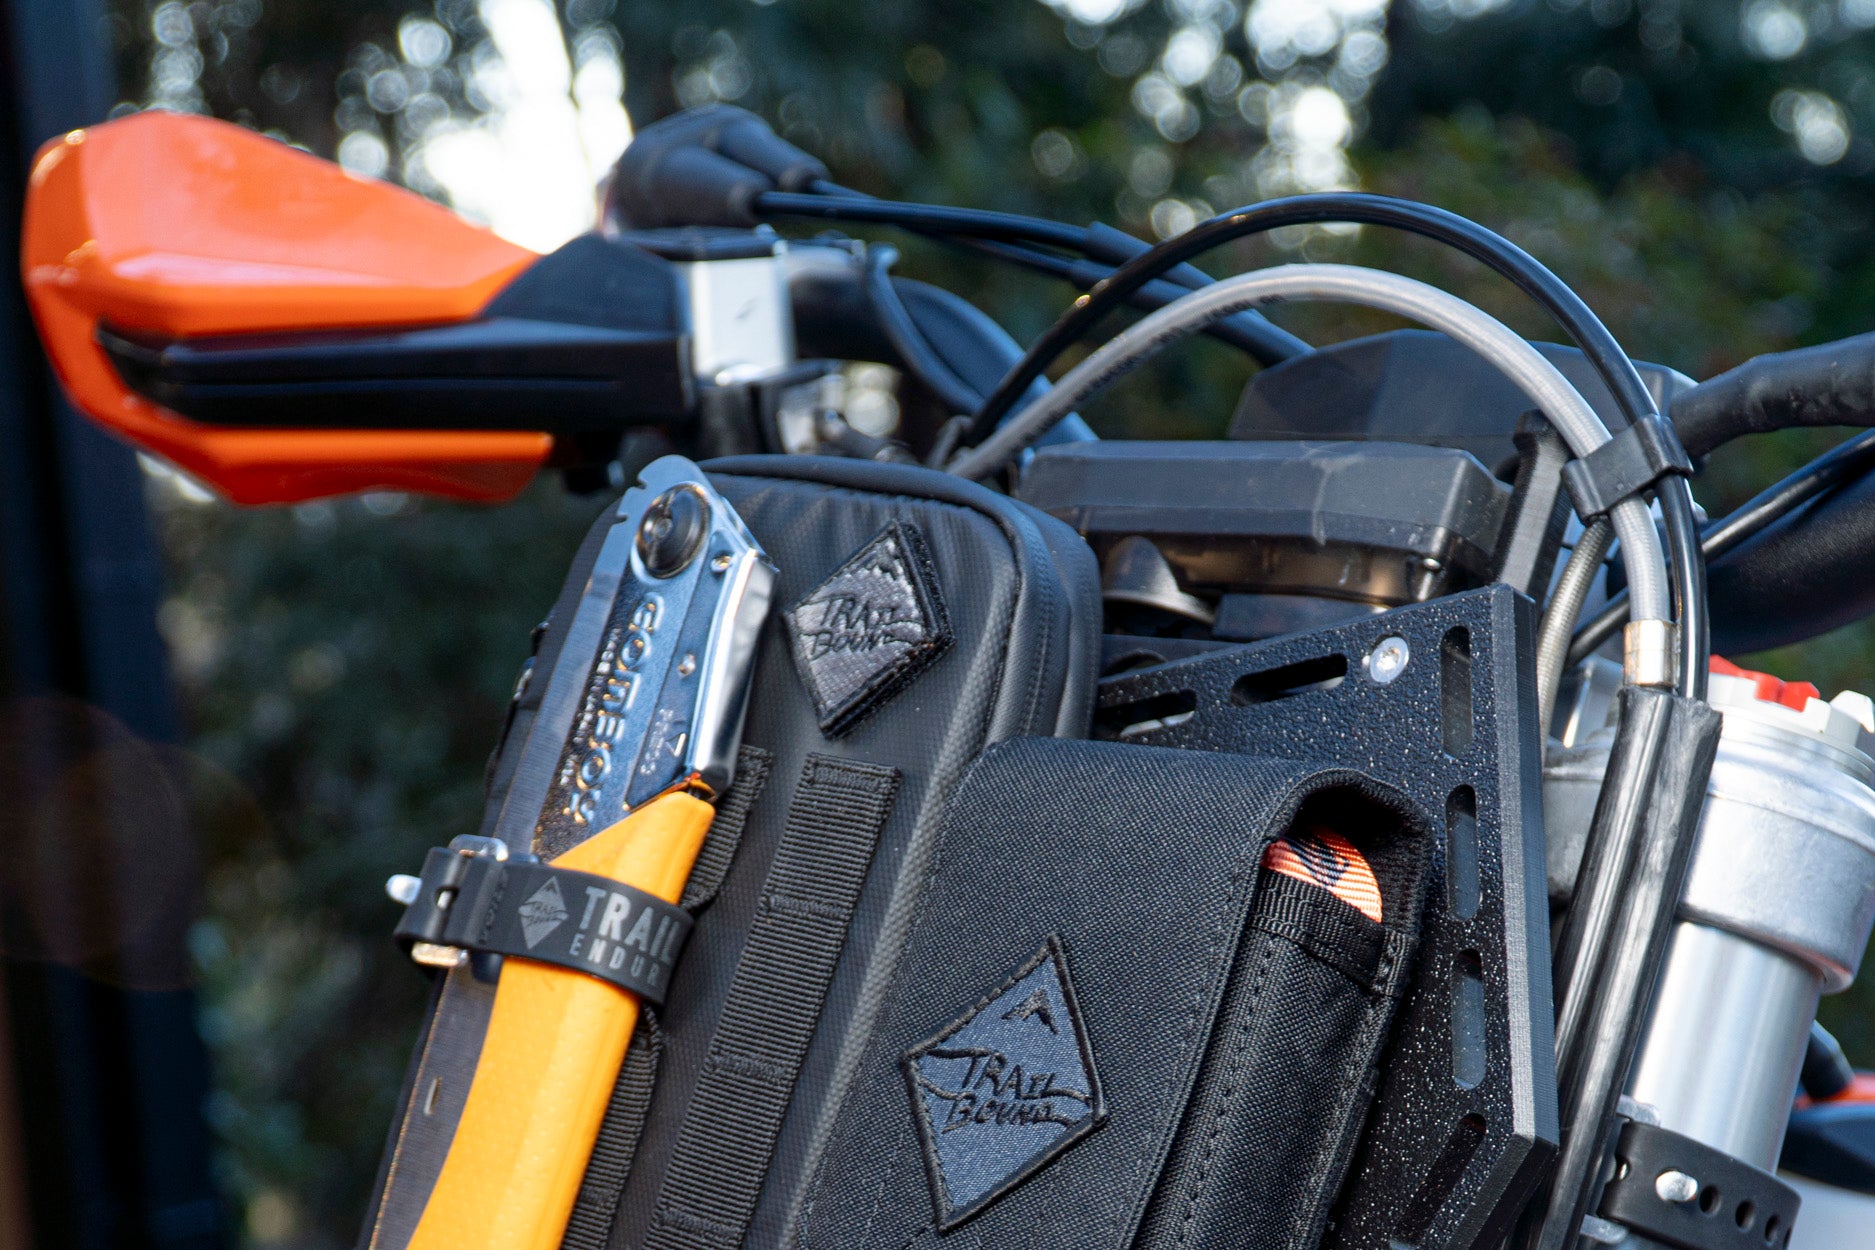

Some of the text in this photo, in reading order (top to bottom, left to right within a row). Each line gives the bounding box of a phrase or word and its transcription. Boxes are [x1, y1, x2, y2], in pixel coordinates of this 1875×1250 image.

[561, 591, 665, 825] GOMBOY
[579, 885, 681, 966] TRAIL
[954, 1050, 1057, 1100] TRAIL
